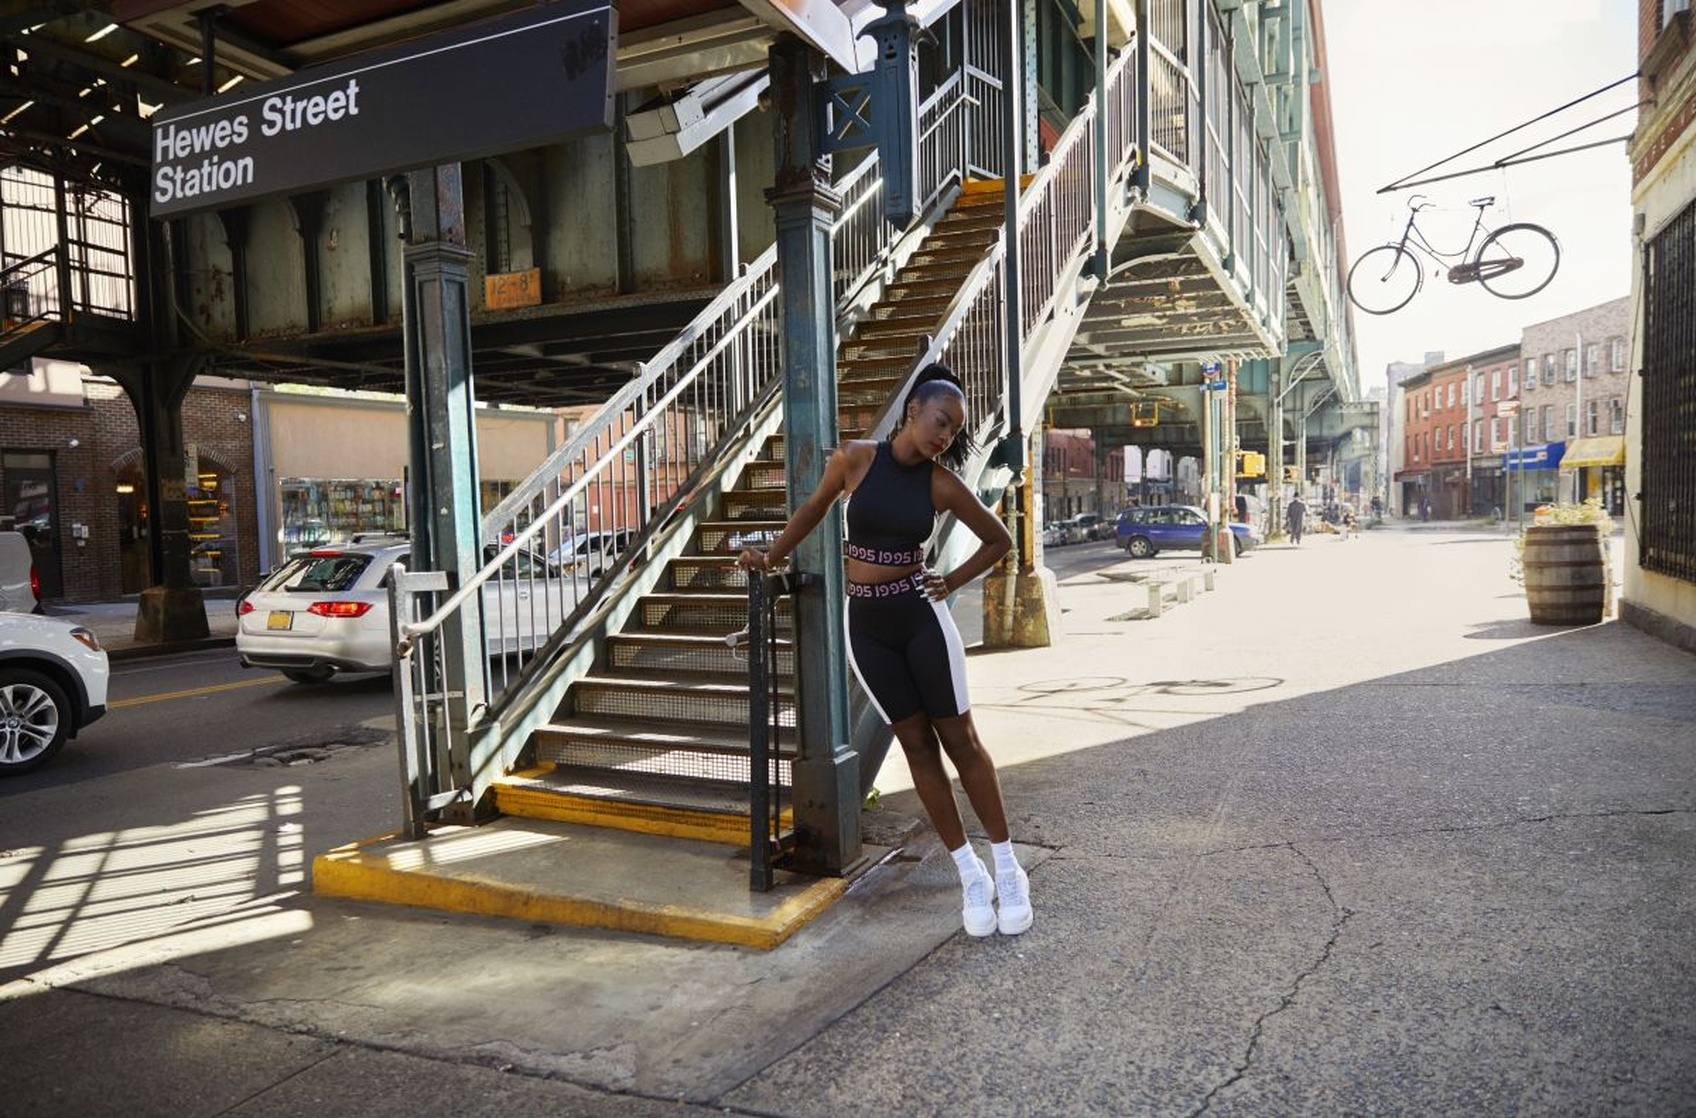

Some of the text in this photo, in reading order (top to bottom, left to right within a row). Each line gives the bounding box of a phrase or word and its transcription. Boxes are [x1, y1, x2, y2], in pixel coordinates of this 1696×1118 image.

[156, 79, 359, 163] Hewes Street
[155, 155, 254, 203] Station
[848, 543, 876, 561] 1995
[878, 551, 911, 564] 1995
[875, 579, 910, 597] 1995
